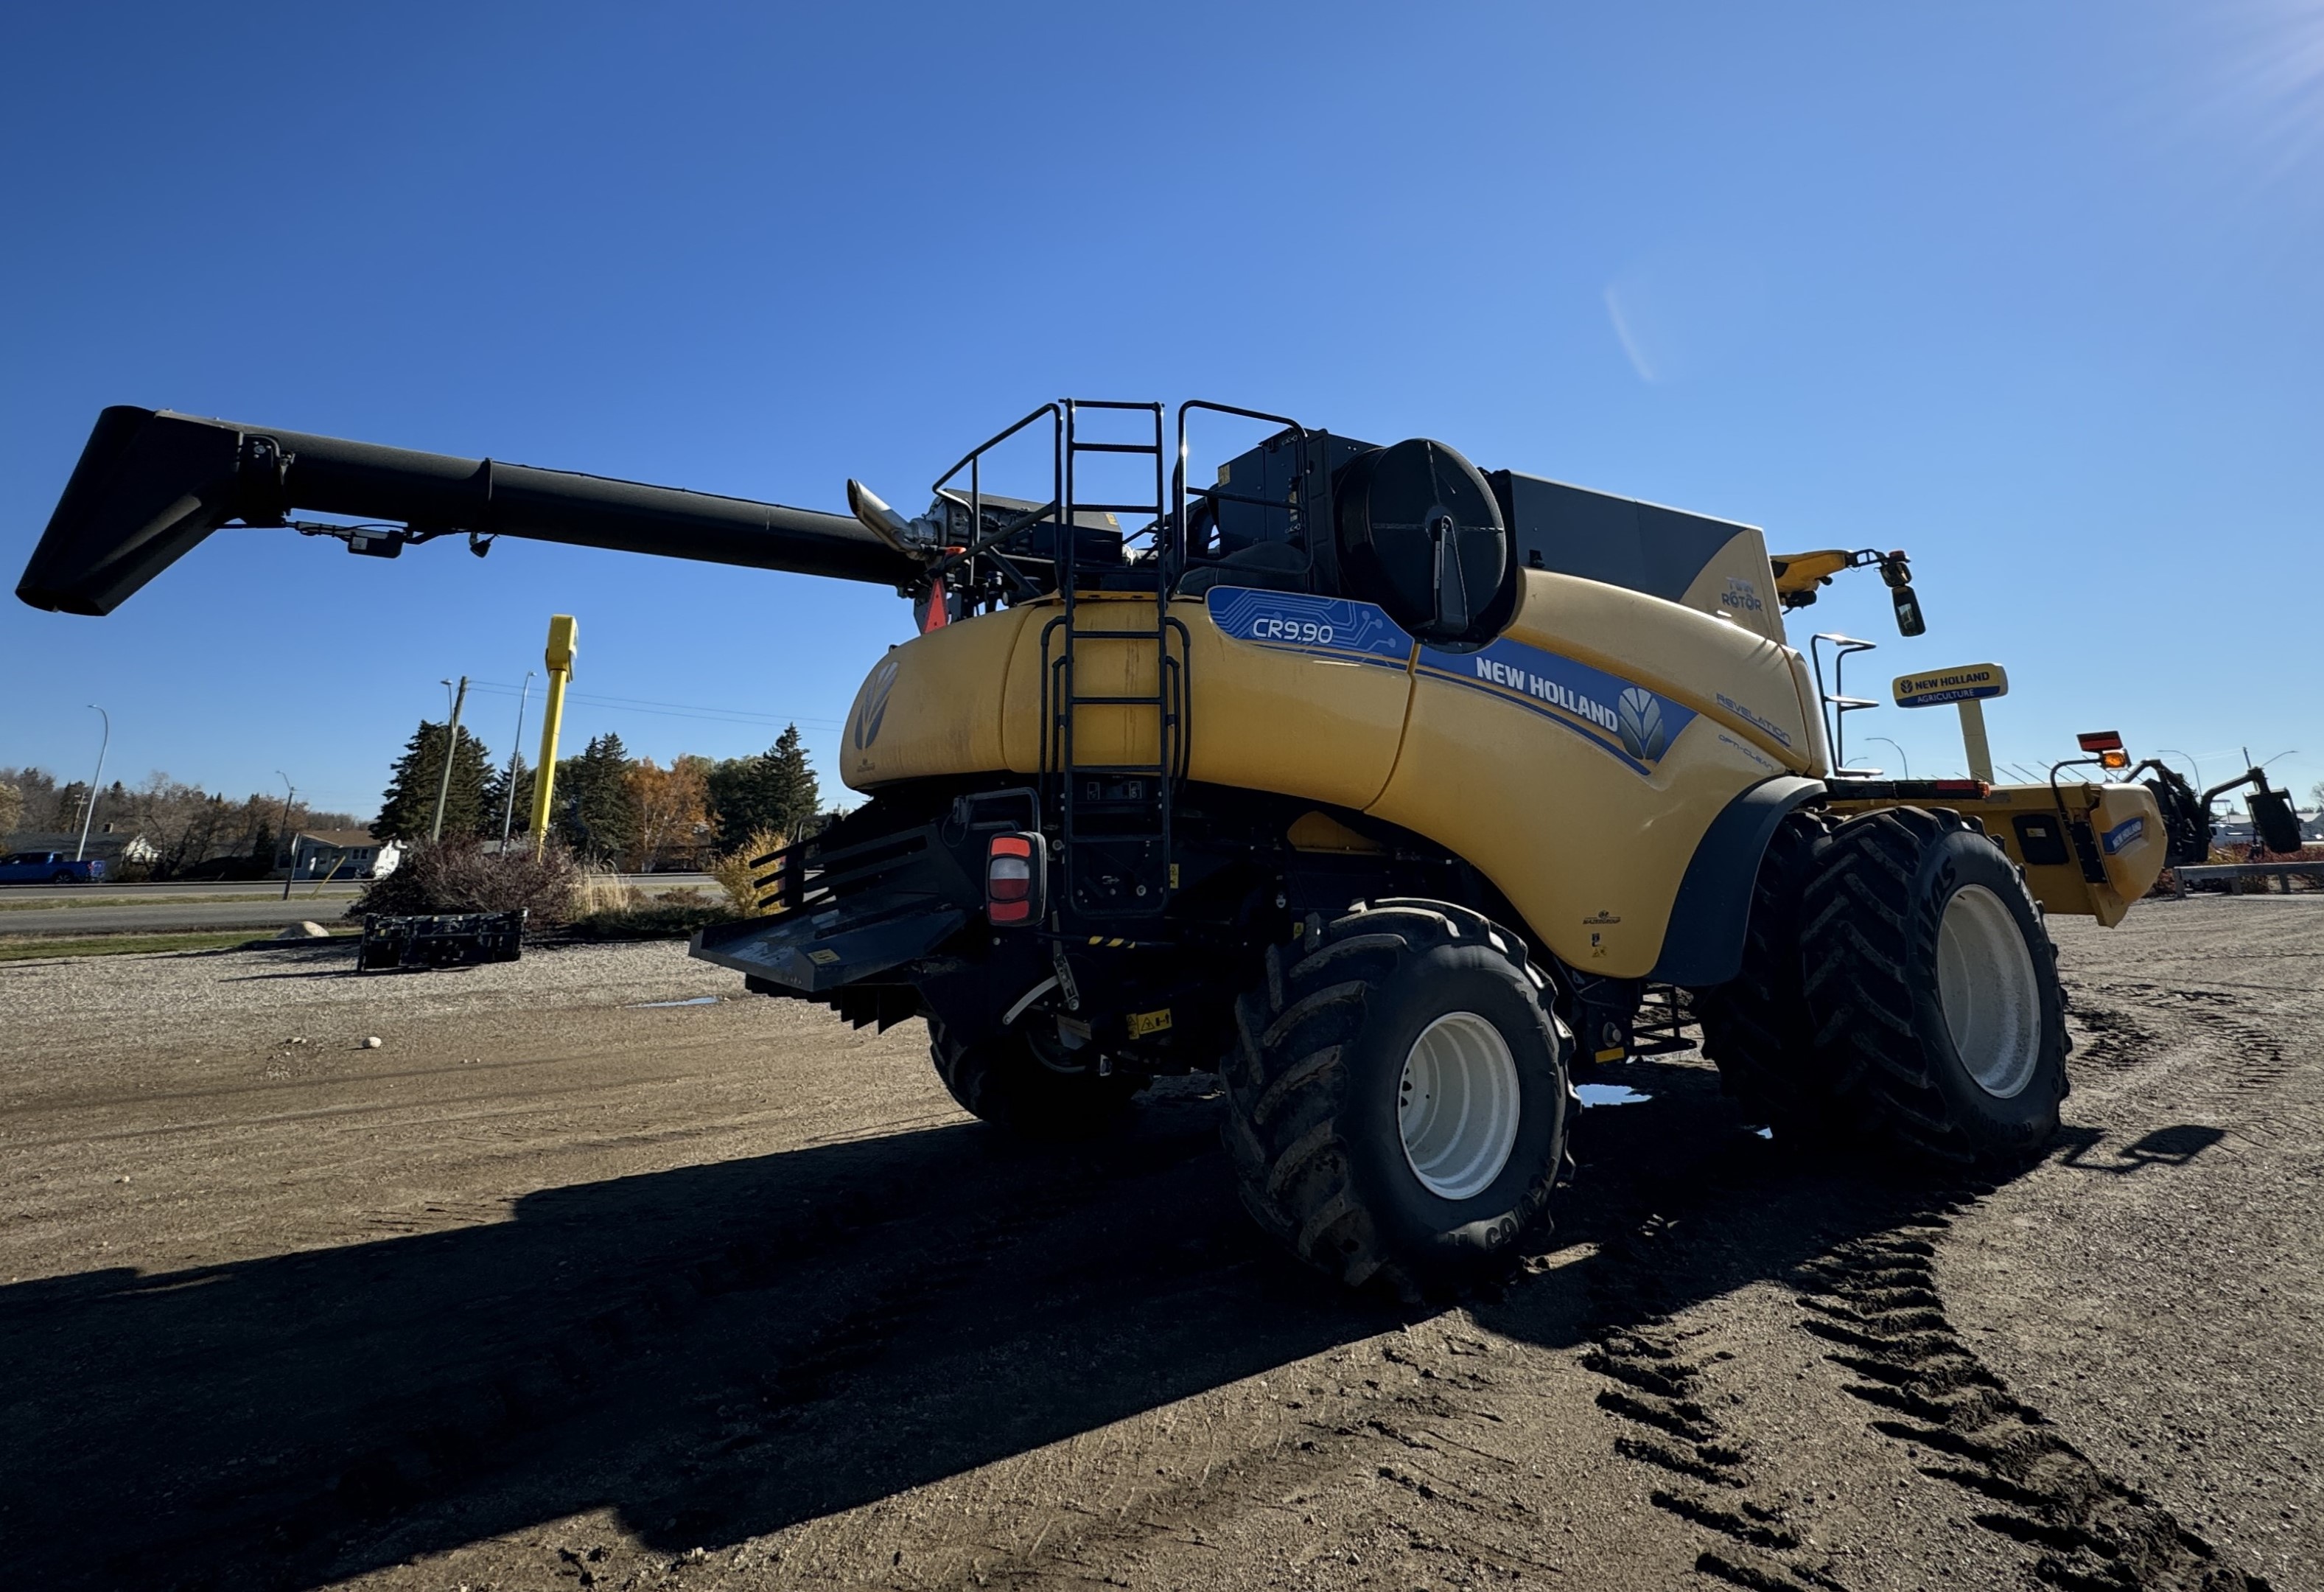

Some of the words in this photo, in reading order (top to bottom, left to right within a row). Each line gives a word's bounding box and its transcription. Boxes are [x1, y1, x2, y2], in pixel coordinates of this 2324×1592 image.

[1721, 591, 1763, 612] ROTOR
[1253, 618, 1334, 644] CR9.90
[1915, 678, 1938, 691] NEW
[1941, 671, 1990, 687] HOLLAND
[1476, 656, 1525, 691] NEW
[1529, 674, 1619, 733] HOLLAND
[1917, 689, 1975, 703] AGRICULTURE
[1716, 693, 1792, 744] REVELATION
[1718, 734, 1774, 772] OPTI-CLEAN
